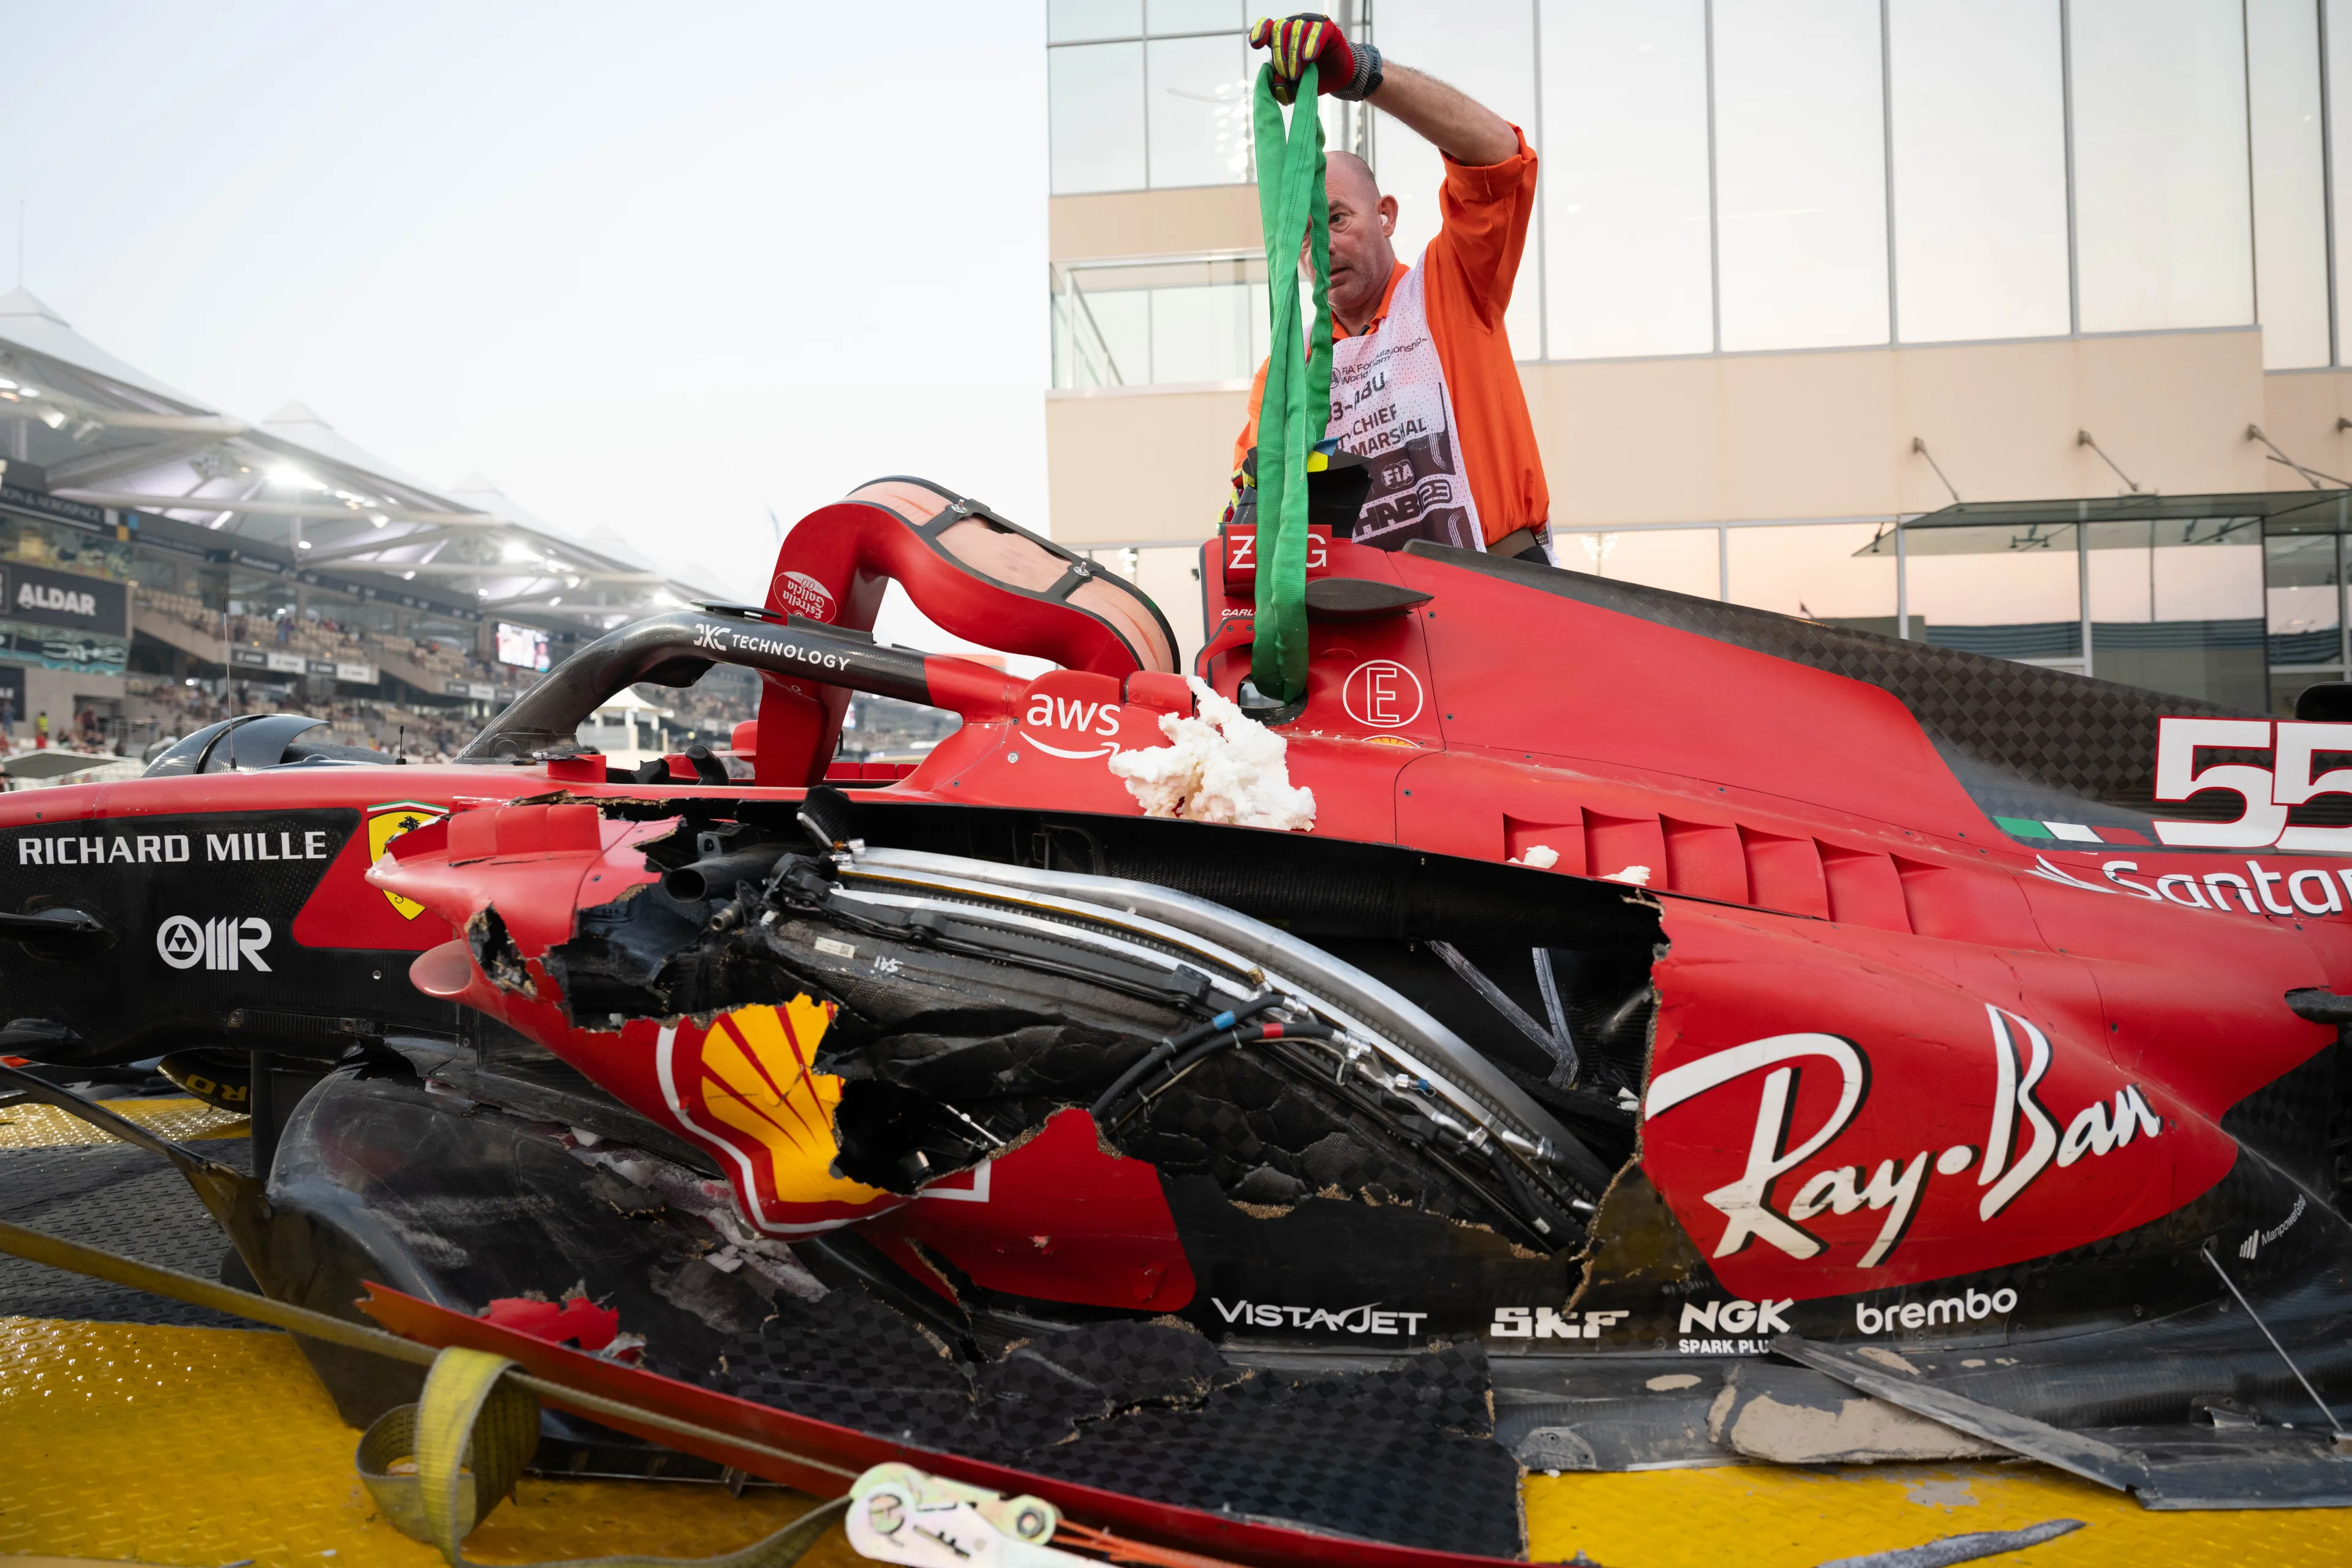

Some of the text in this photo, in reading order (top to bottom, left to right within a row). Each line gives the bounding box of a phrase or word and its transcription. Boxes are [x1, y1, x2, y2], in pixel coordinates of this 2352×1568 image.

[1341, 369, 1369, 385] World
[1357, 349, 1391, 373] Forula
[1327, 371, 1385, 424] 3-ABU
[1229, 533, 1326, 569] ZG
[17, 582, 97, 616] ALDAR
[782, 590, 824, 620] Estrella
[787, 580, 825, 608] Galicia
[732, 634, 850, 671] TECHNOLOGY
[1366, 666, 1400, 723] E
[1026, 693, 1121, 736] aws
[2150, 715, 2352, 851] 55
[18, 831, 327, 865] RICHARD MILLE
[1490, 1306, 1630, 1338] SKF
[1679, 1297, 1795, 1334] NGK
[1856, 1287, 2018, 1334] brembo
[1679, 1339, 1770, 1354] SPARK PLU
